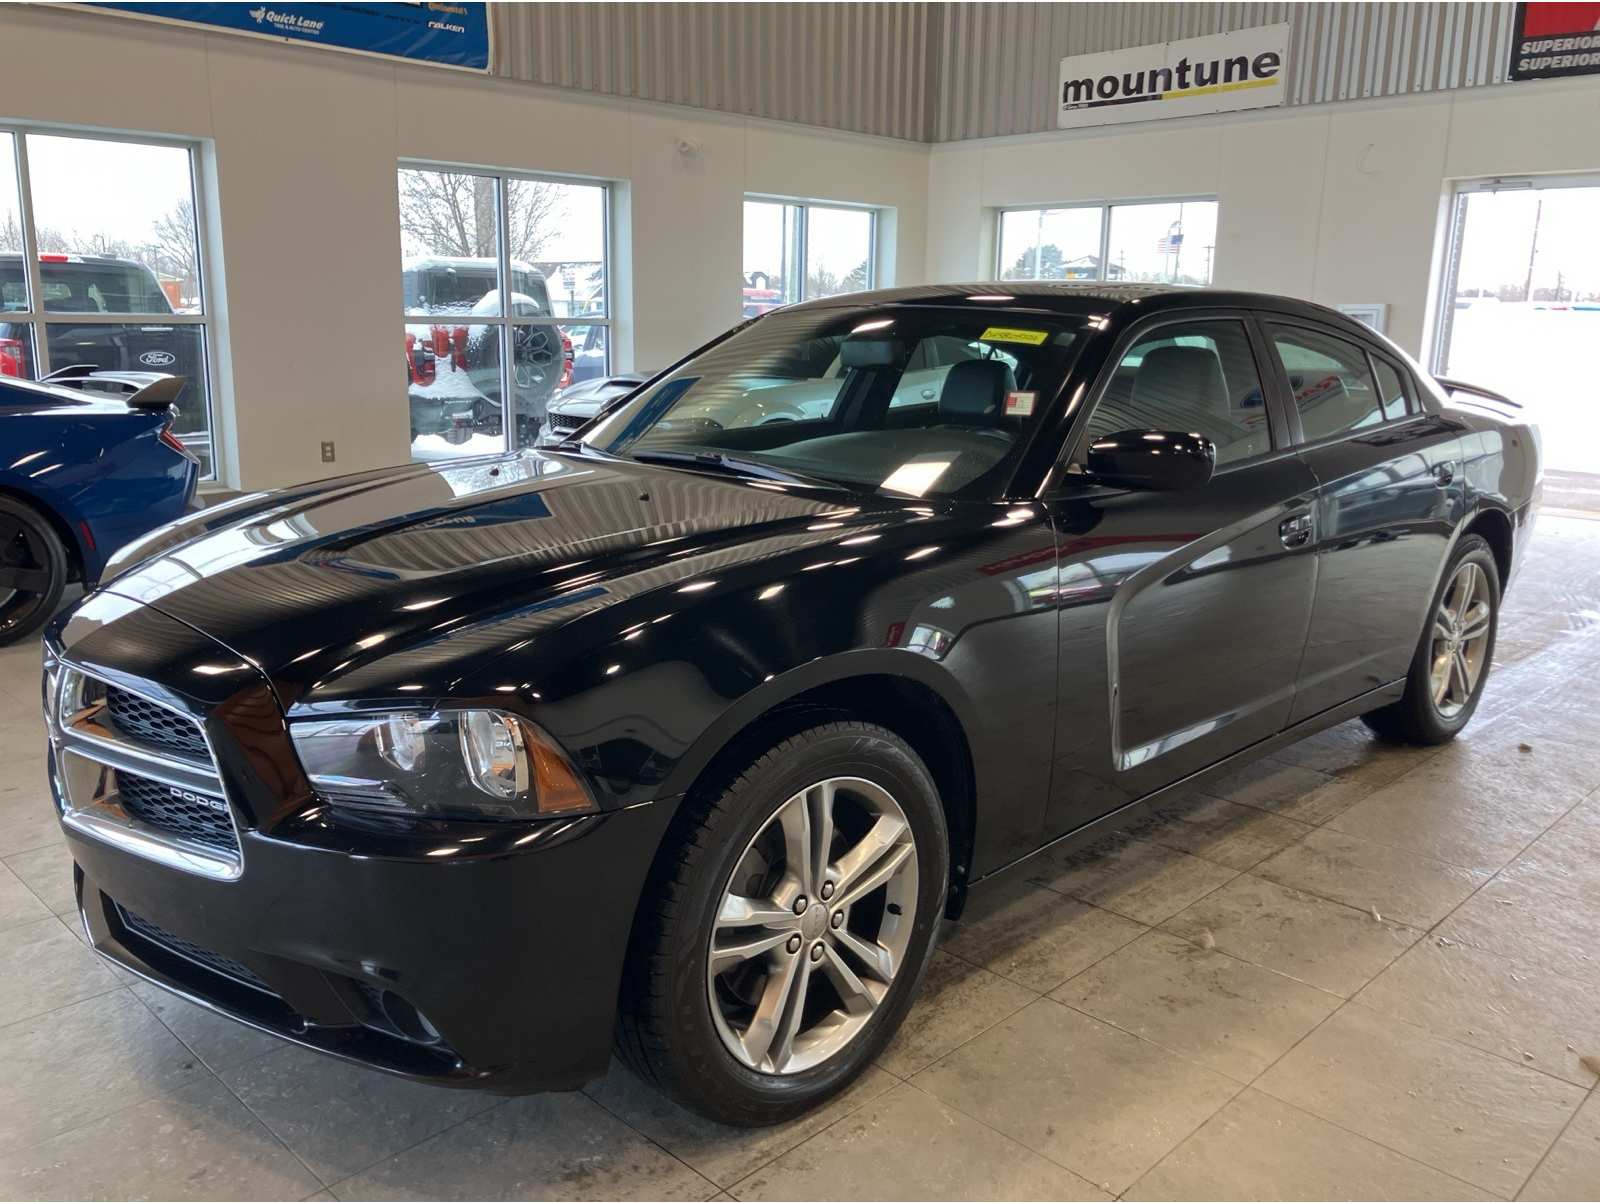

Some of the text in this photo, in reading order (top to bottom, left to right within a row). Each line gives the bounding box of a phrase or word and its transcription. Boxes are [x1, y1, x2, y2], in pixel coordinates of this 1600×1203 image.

[266, 11, 324, 29] Quick Lane
[428, 21, 465, 33] FALKEN
[1520, 35, 1600, 54] SUPERIOR
[1518, 53, 1600, 71] SUPERIOR
[1063, 52, 1280, 104] mountune
[146, 353, 169, 363] Ford
